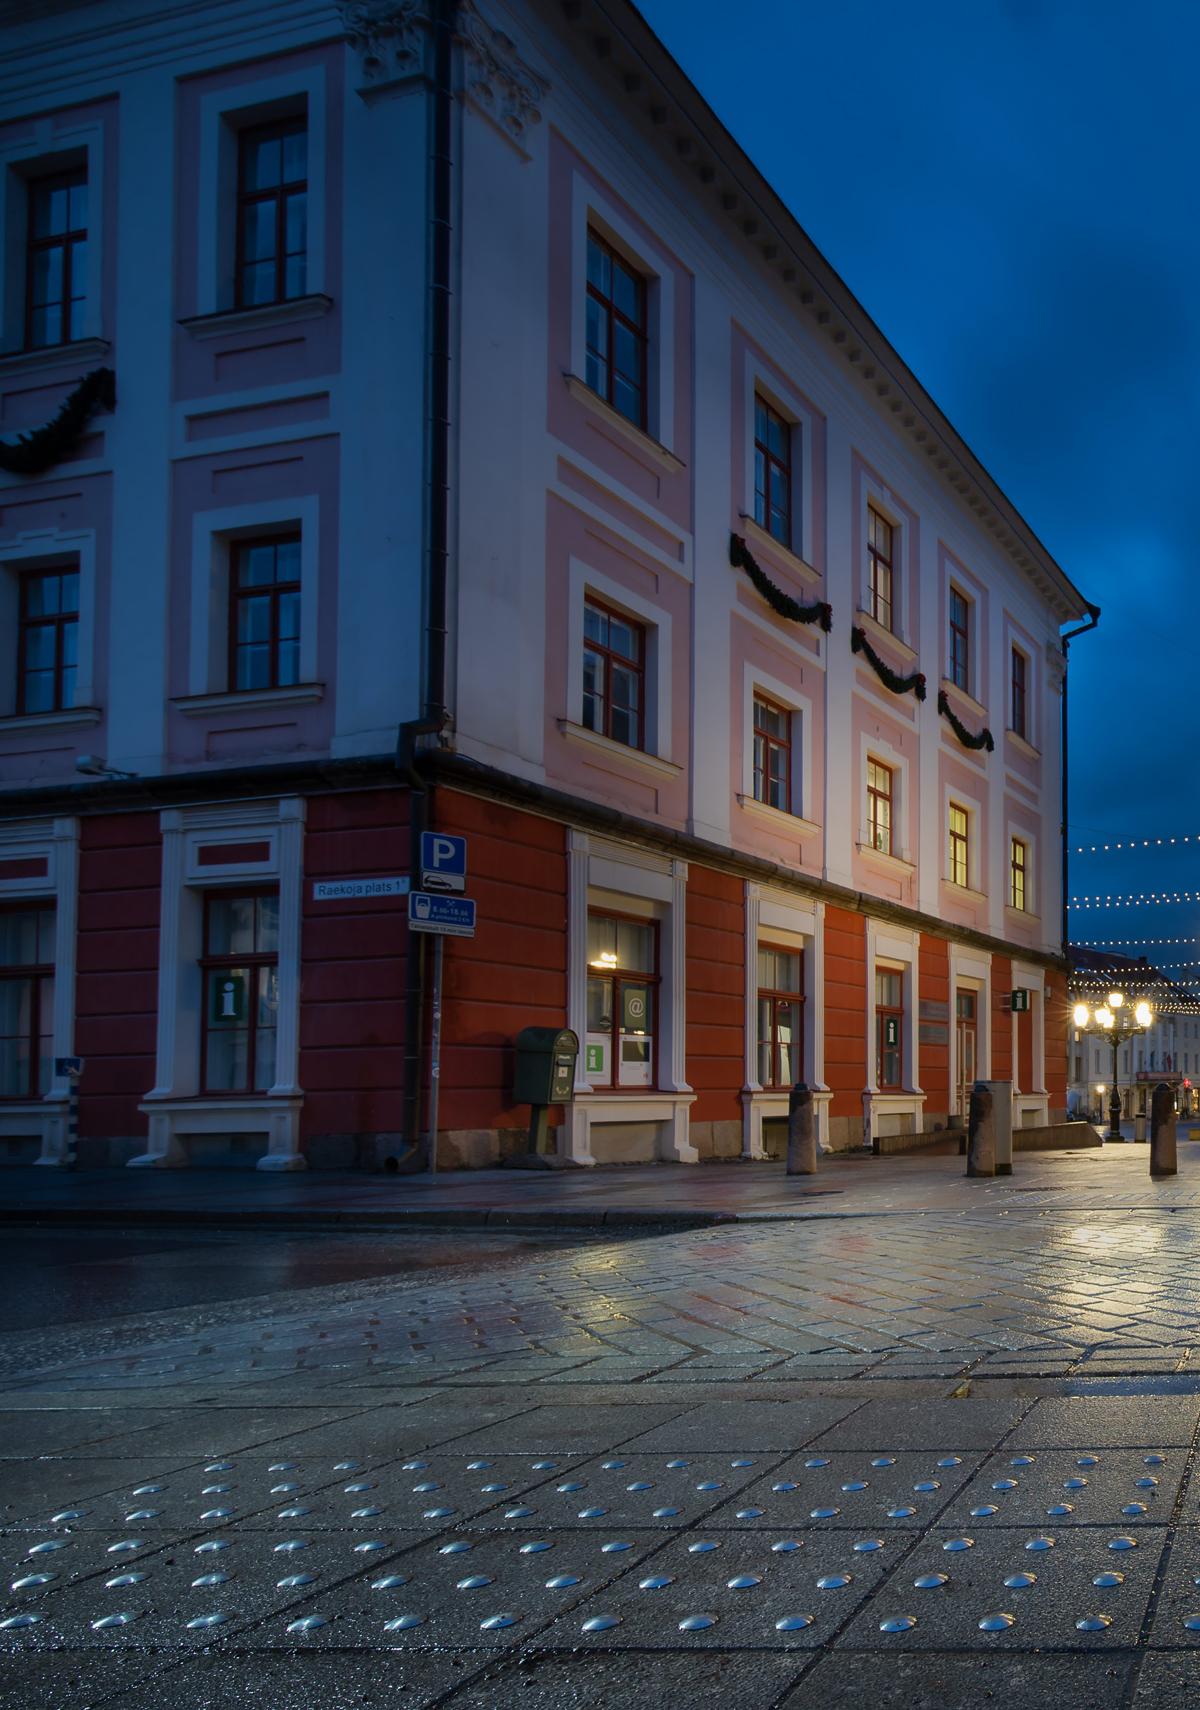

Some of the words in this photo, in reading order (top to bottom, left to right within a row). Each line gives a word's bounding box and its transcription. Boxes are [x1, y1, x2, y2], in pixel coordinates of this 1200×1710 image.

[433, 838, 456, 868] P
[318, 884, 363, 897] Raekoja
[365, 881, 392, 896] plats
